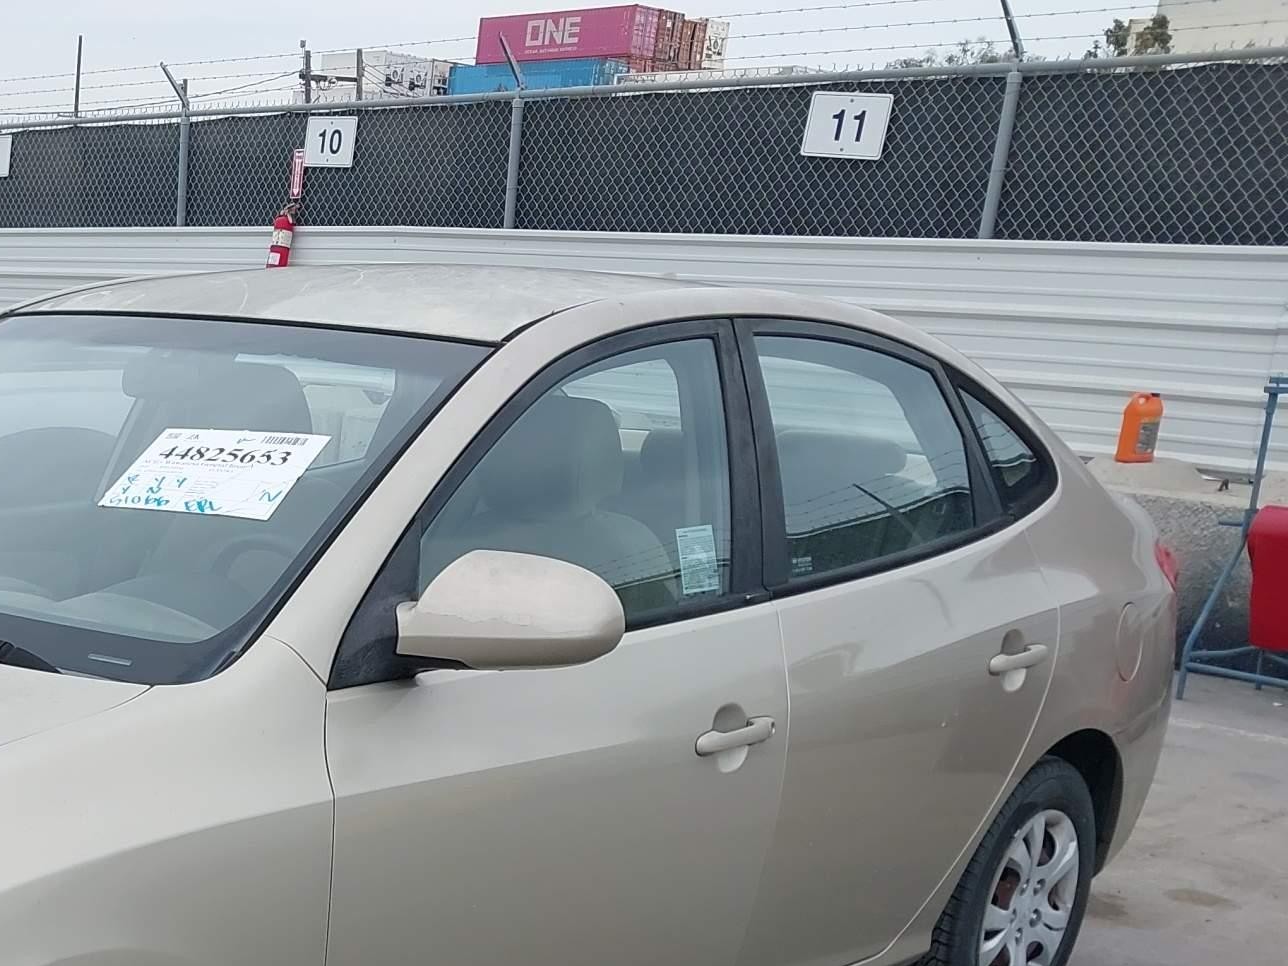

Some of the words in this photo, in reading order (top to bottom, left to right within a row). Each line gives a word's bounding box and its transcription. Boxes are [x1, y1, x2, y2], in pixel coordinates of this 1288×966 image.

[524, 16, 582, 47] ONE
[832, 109, 867, 142] 11
[318, 128, 342, 155] 10
[159, 445, 292, 466] 44825653
